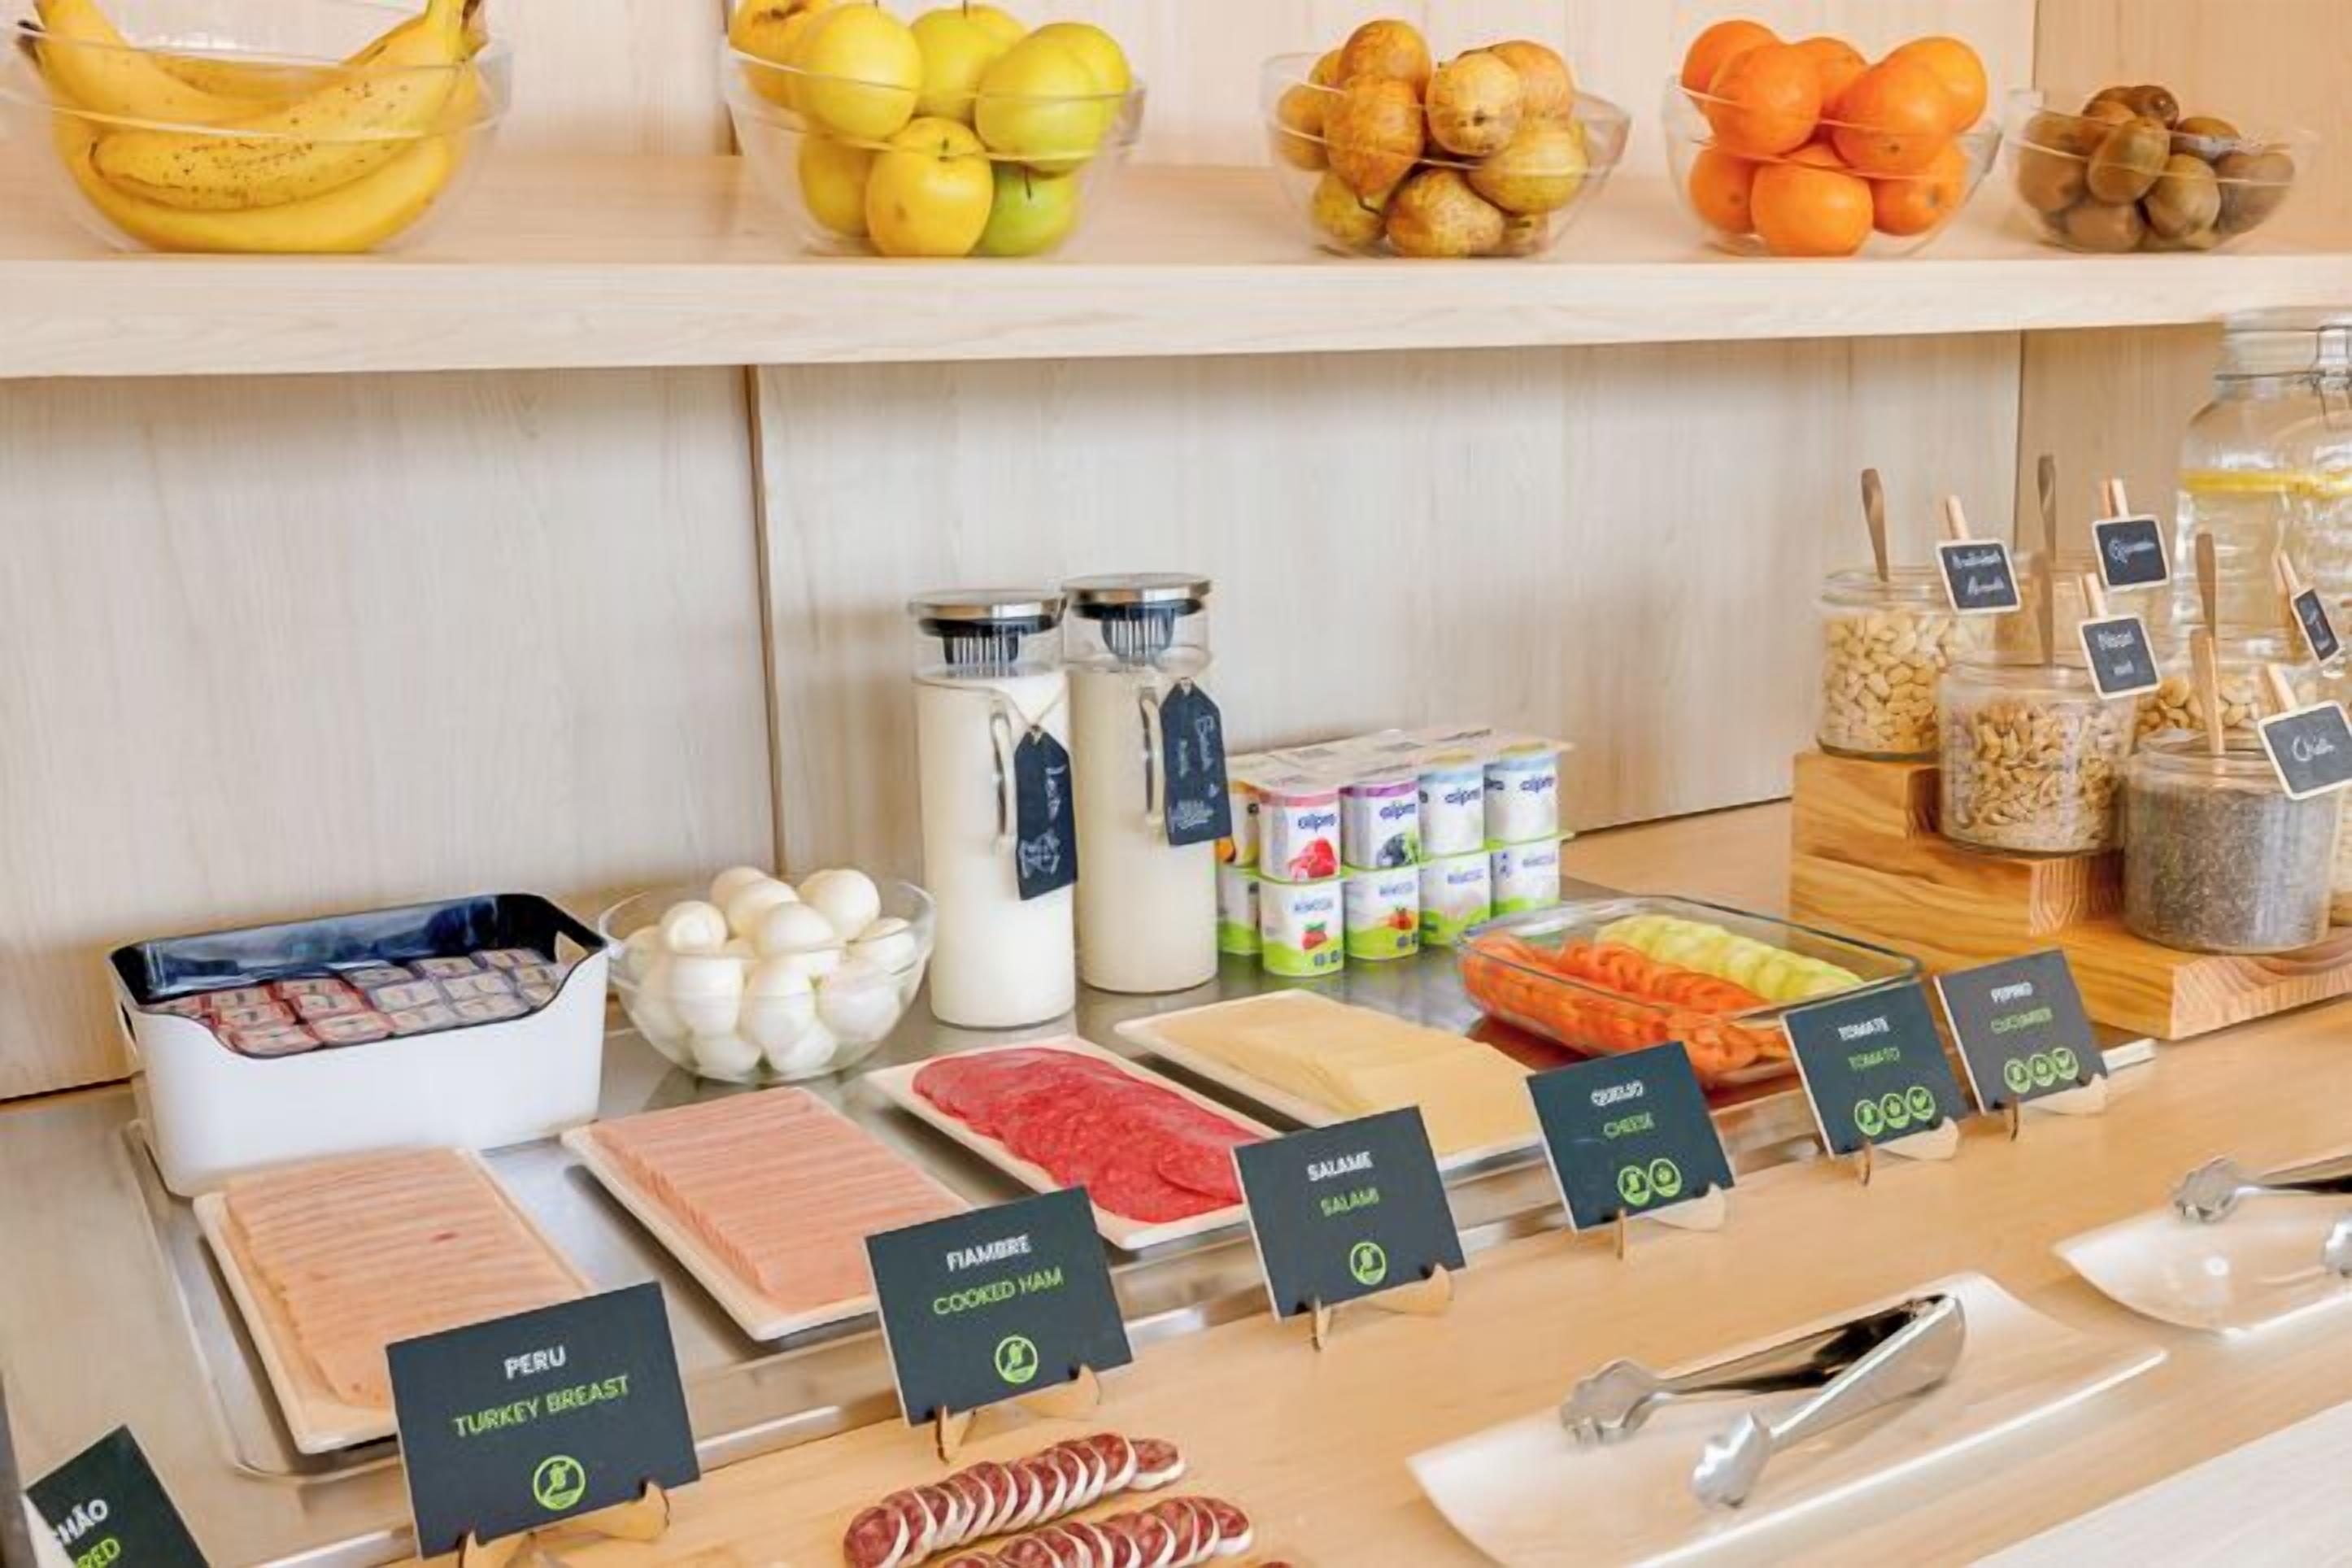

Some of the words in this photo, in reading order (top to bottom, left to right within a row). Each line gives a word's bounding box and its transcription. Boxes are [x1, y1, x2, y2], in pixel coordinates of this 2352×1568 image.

[1991, 982, 2033, 1003] PPO
[1307, 1151, 1374, 1182] SALAME
[946, 1234, 1032, 1272] FIAMBRE
[933, 1280, 1015, 1315] COOKED
[1018, 1266, 1065, 1294] HAM
[503, 1344, 567, 1380] PERU
[452, 1397, 538, 1438] TURKEY
[546, 1374, 629, 1413] BREAST
